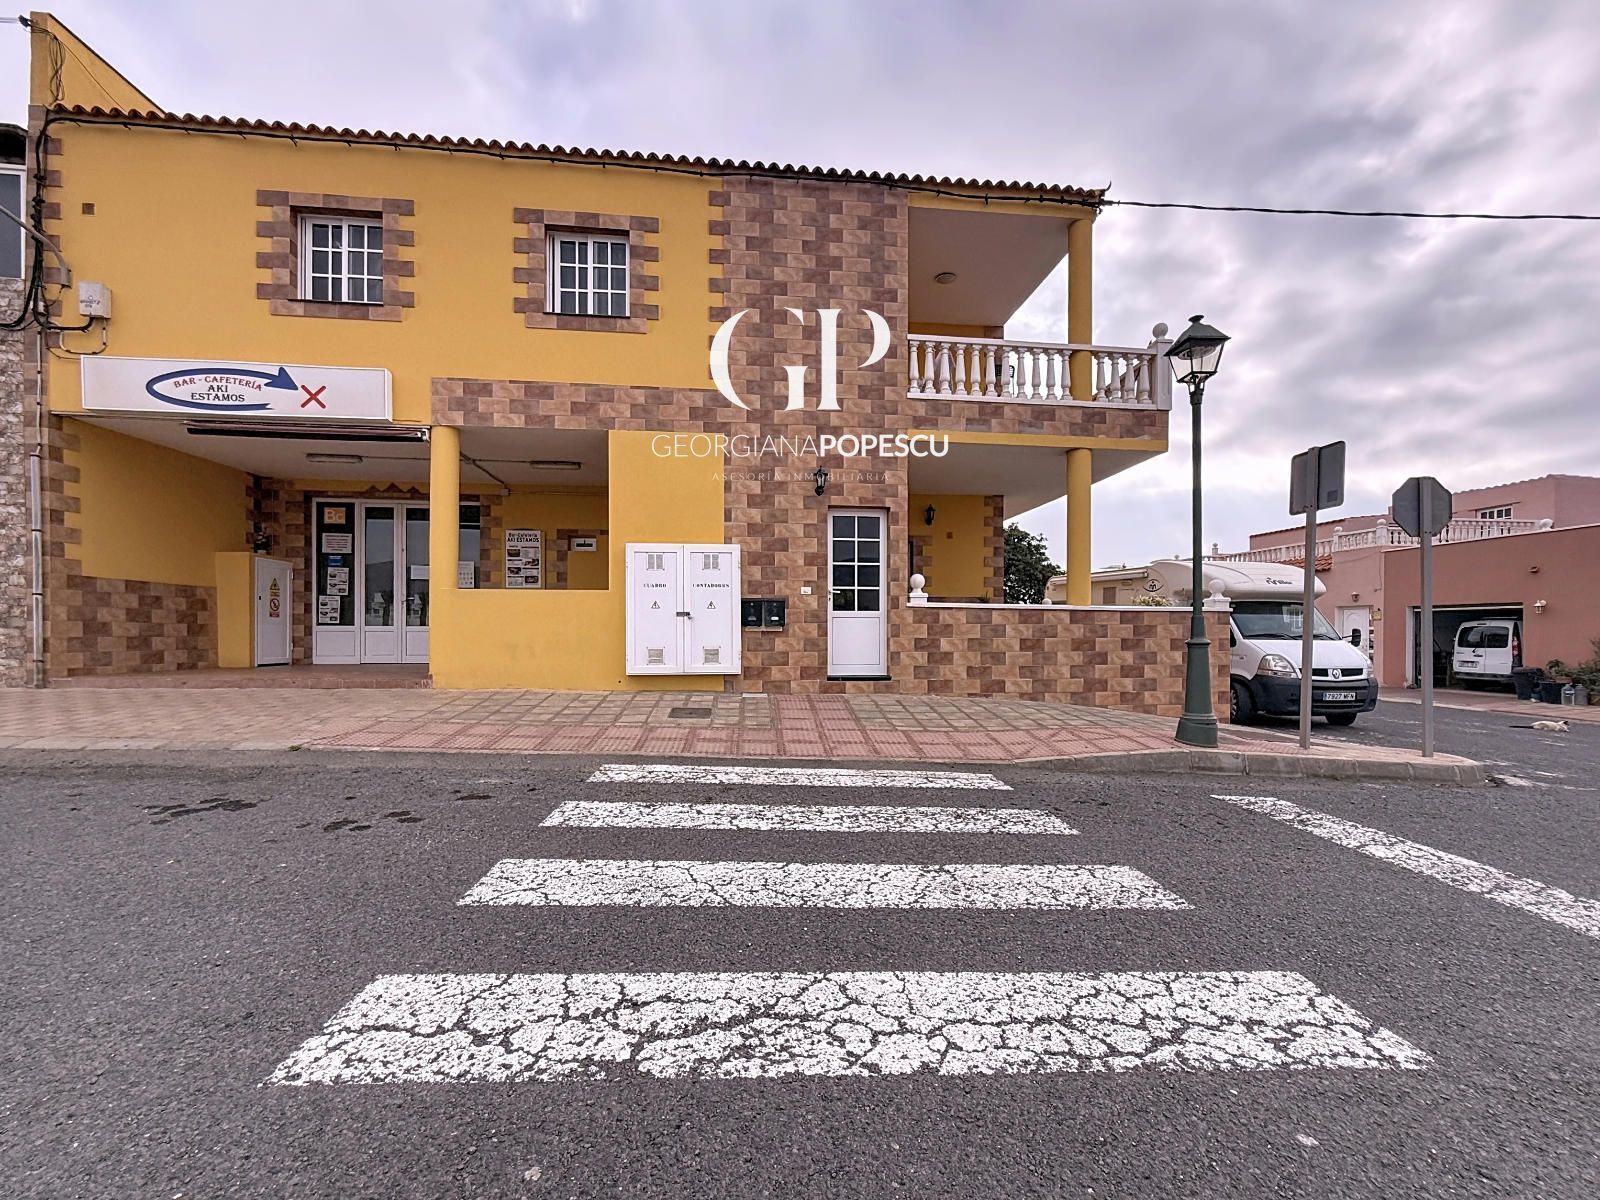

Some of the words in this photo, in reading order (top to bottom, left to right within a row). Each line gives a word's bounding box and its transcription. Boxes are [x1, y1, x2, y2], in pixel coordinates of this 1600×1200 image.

[174, 376, 197, 389] BAR
[204, 376, 263, 391] CAFETERÍA
[207, 384, 228, 393] AKI
[190, 392, 246, 402] ESTAMOS
